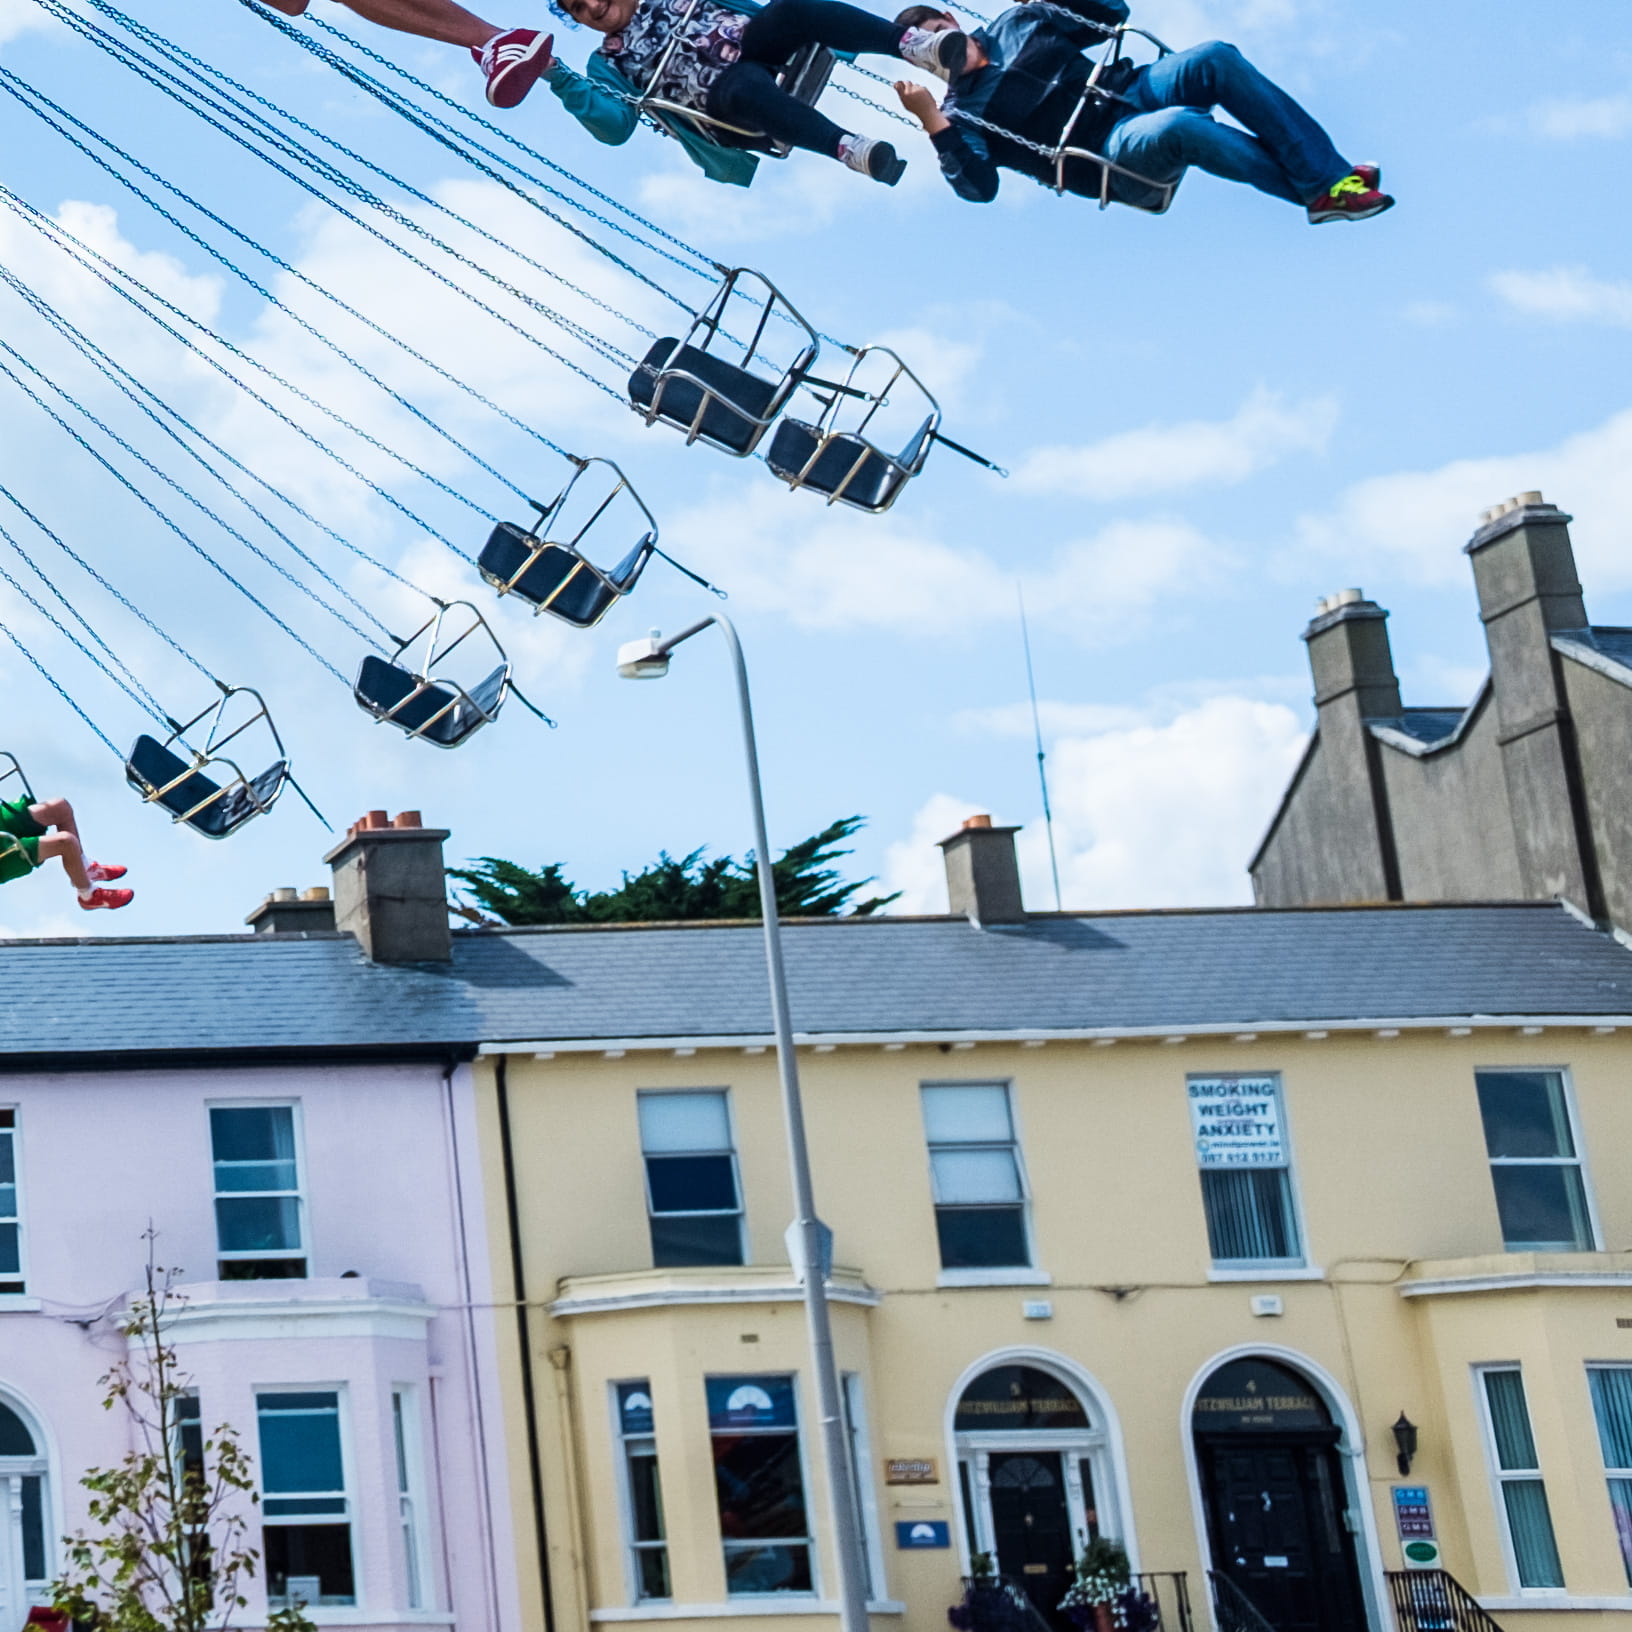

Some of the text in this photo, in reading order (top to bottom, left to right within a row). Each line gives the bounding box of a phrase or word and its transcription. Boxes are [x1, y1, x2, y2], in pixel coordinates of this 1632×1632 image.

[1189, 1083, 1275, 1097] SMOKING
[1198, 1103, 1268, 1116] WEIGHT
[1199, 1123, 1275, 1136] ANXIETY
